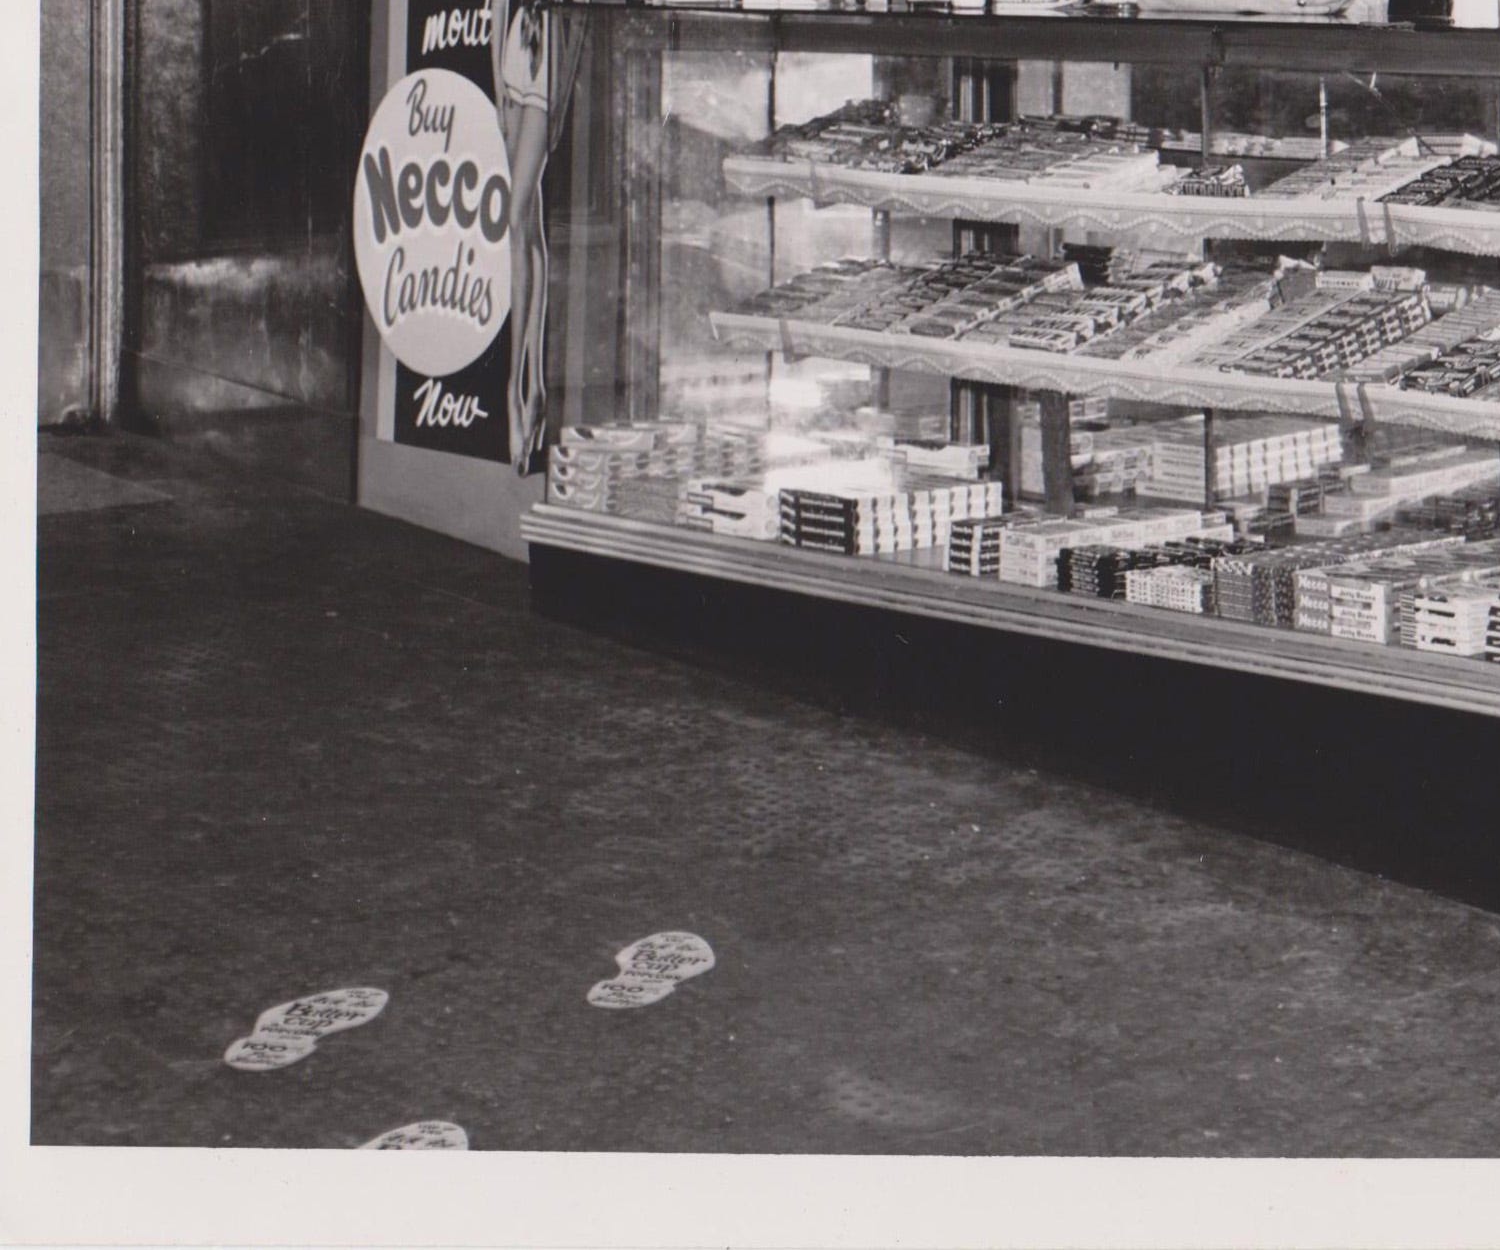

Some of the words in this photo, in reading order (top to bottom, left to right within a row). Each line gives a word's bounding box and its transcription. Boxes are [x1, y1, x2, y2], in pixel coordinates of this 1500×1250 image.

[407, 79, 456, 153] Buy
[364, 146, 511, 244] Necco
[383, 240, 494, 327] Candies
[413, 377, 489, 429] Now
